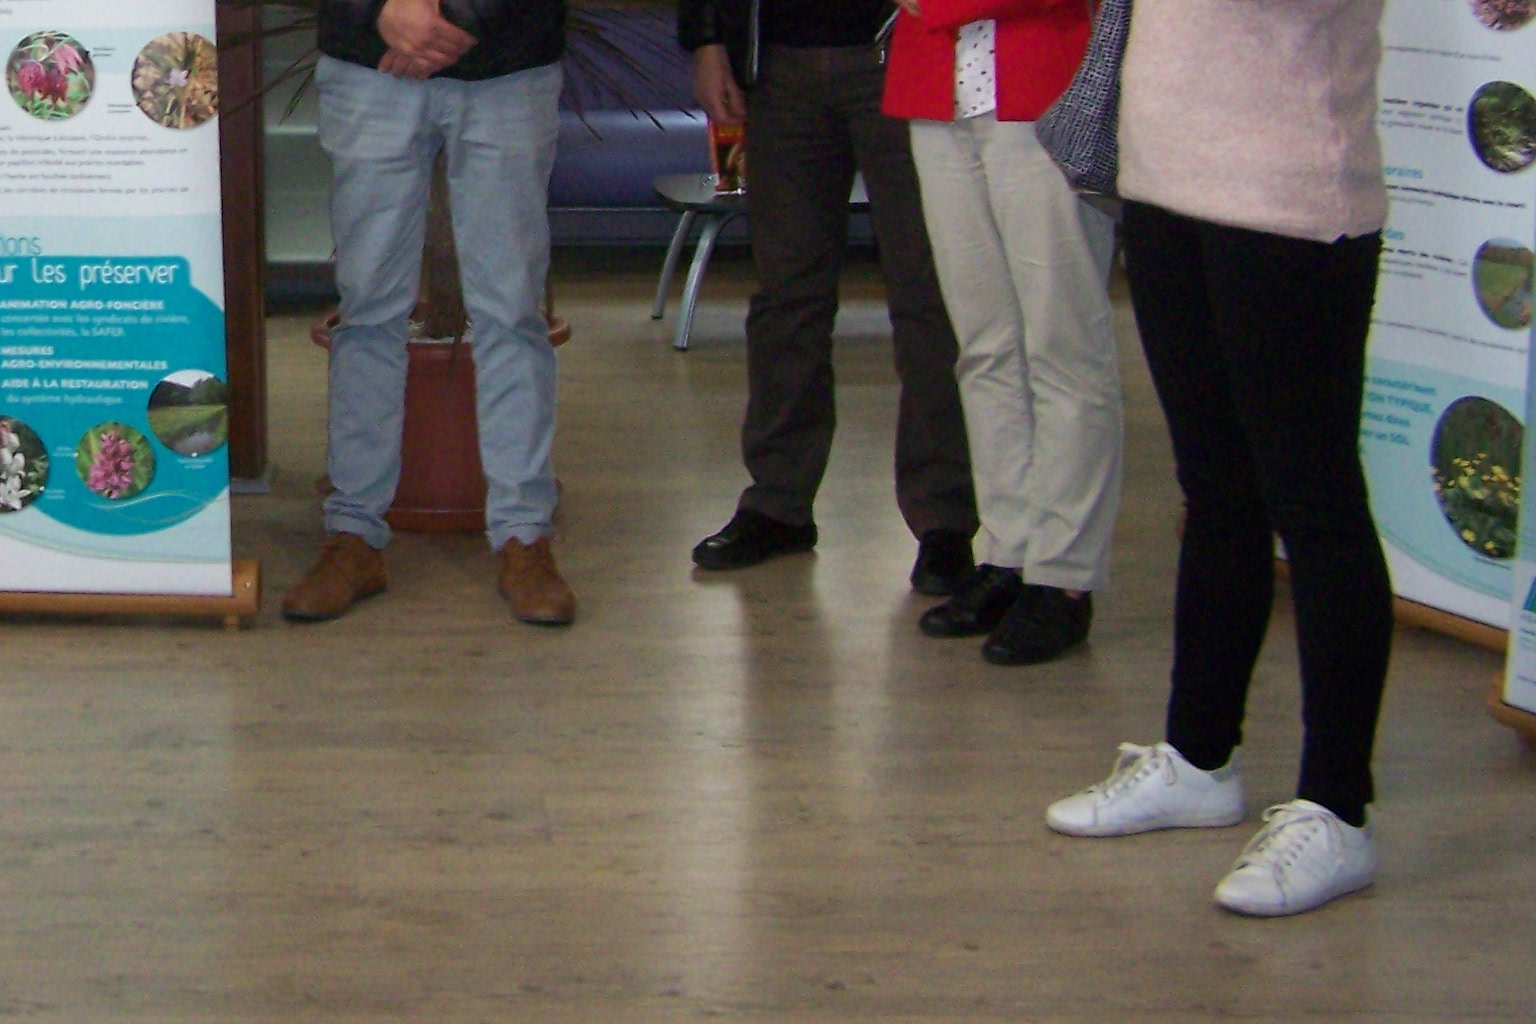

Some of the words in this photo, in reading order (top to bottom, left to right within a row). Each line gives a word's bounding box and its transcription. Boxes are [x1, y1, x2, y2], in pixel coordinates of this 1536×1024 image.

[31, 256, 68, 285] les
[79, 259, 181, 292] préserver
[0, 345, 55, 357] MESURES
[0, 358, 169, 371] AGRO-ENVIRONNEMENTALES
[1, 378, 30, 389] AIDE
[43, 378, 60, 389] LA
[60, 378, 150, 390] RESTAURATION
